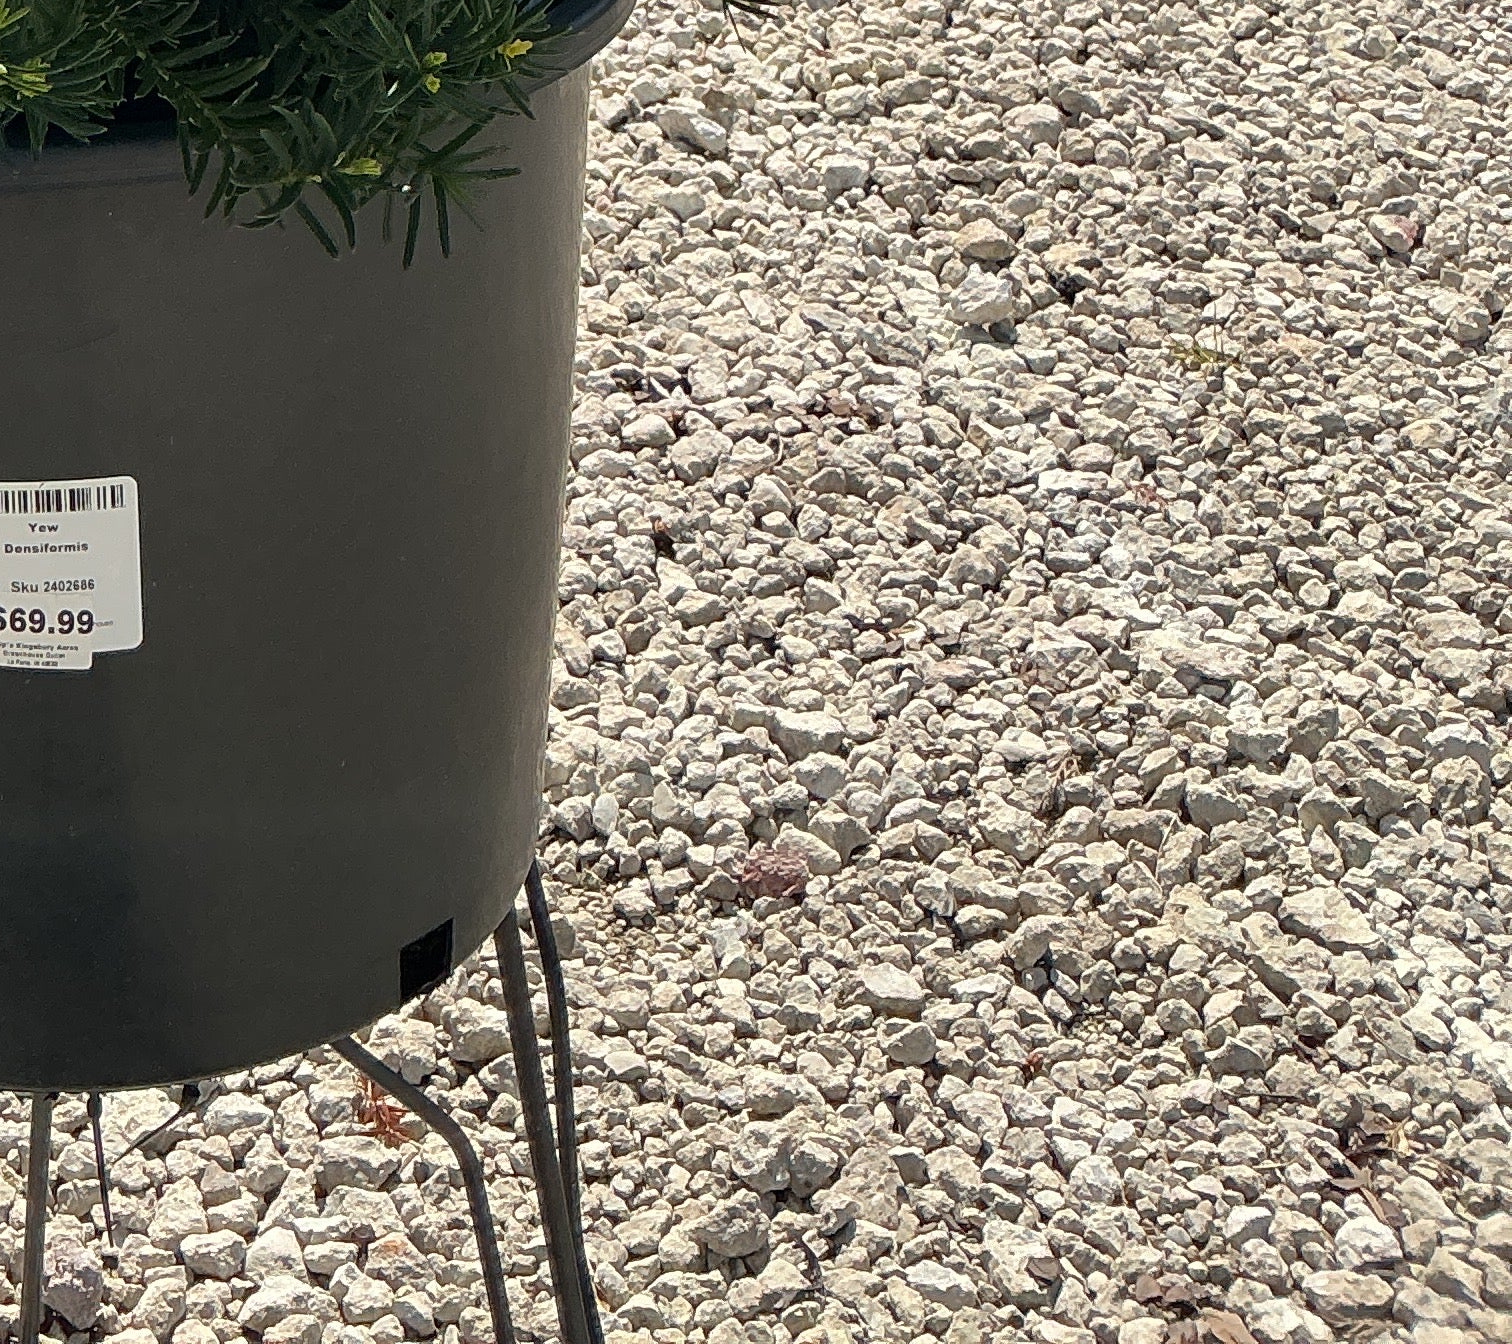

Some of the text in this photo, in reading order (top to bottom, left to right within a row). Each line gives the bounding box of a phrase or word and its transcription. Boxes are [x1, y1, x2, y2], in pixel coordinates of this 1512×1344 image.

[28, 522, 59, 533] Yew
[4, 541, 89, 554] Densiformis
[10, 581, 39, 593] Sku
[43, 578, 95, 593] 2402686
